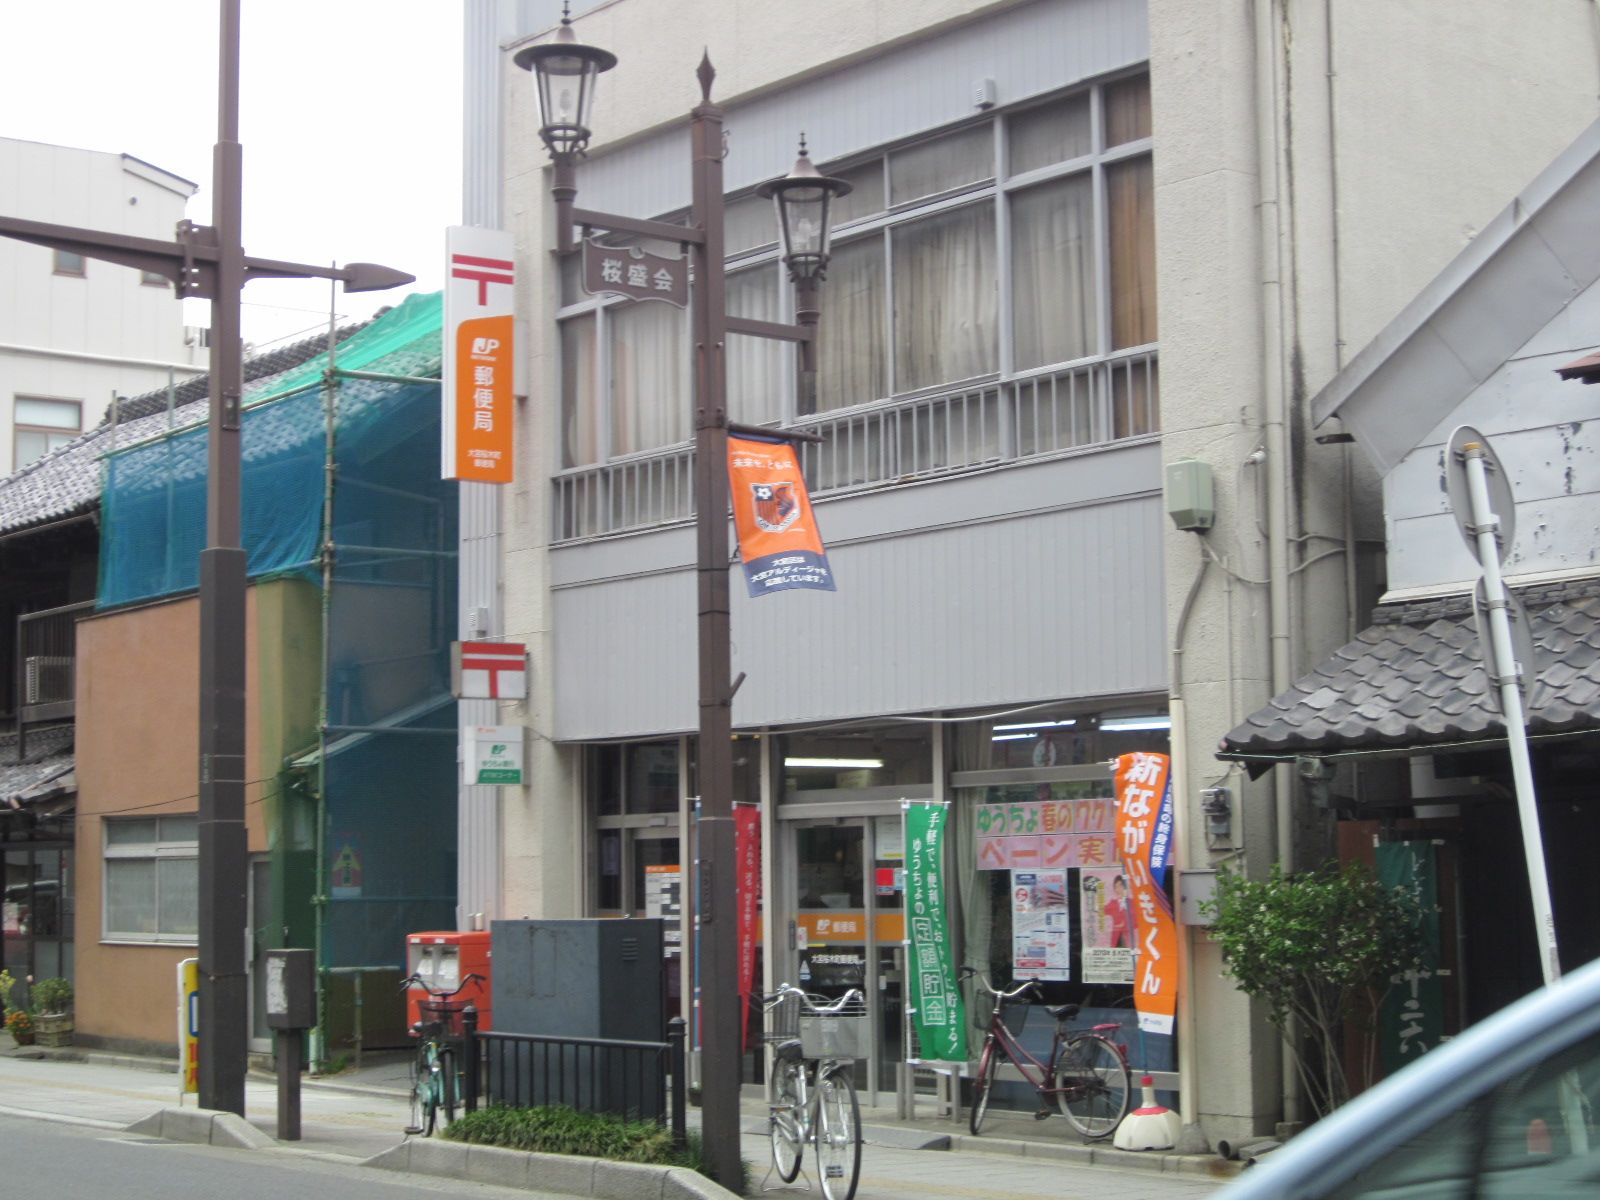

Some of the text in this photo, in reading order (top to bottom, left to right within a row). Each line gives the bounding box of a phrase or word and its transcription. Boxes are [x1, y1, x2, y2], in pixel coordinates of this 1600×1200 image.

[474, 365, 494, 432] 郵便局
[977, 802, 1115, 833] ゆうちょ春のワク
[1122, 752, 1163, 996] 新ながいきくん
